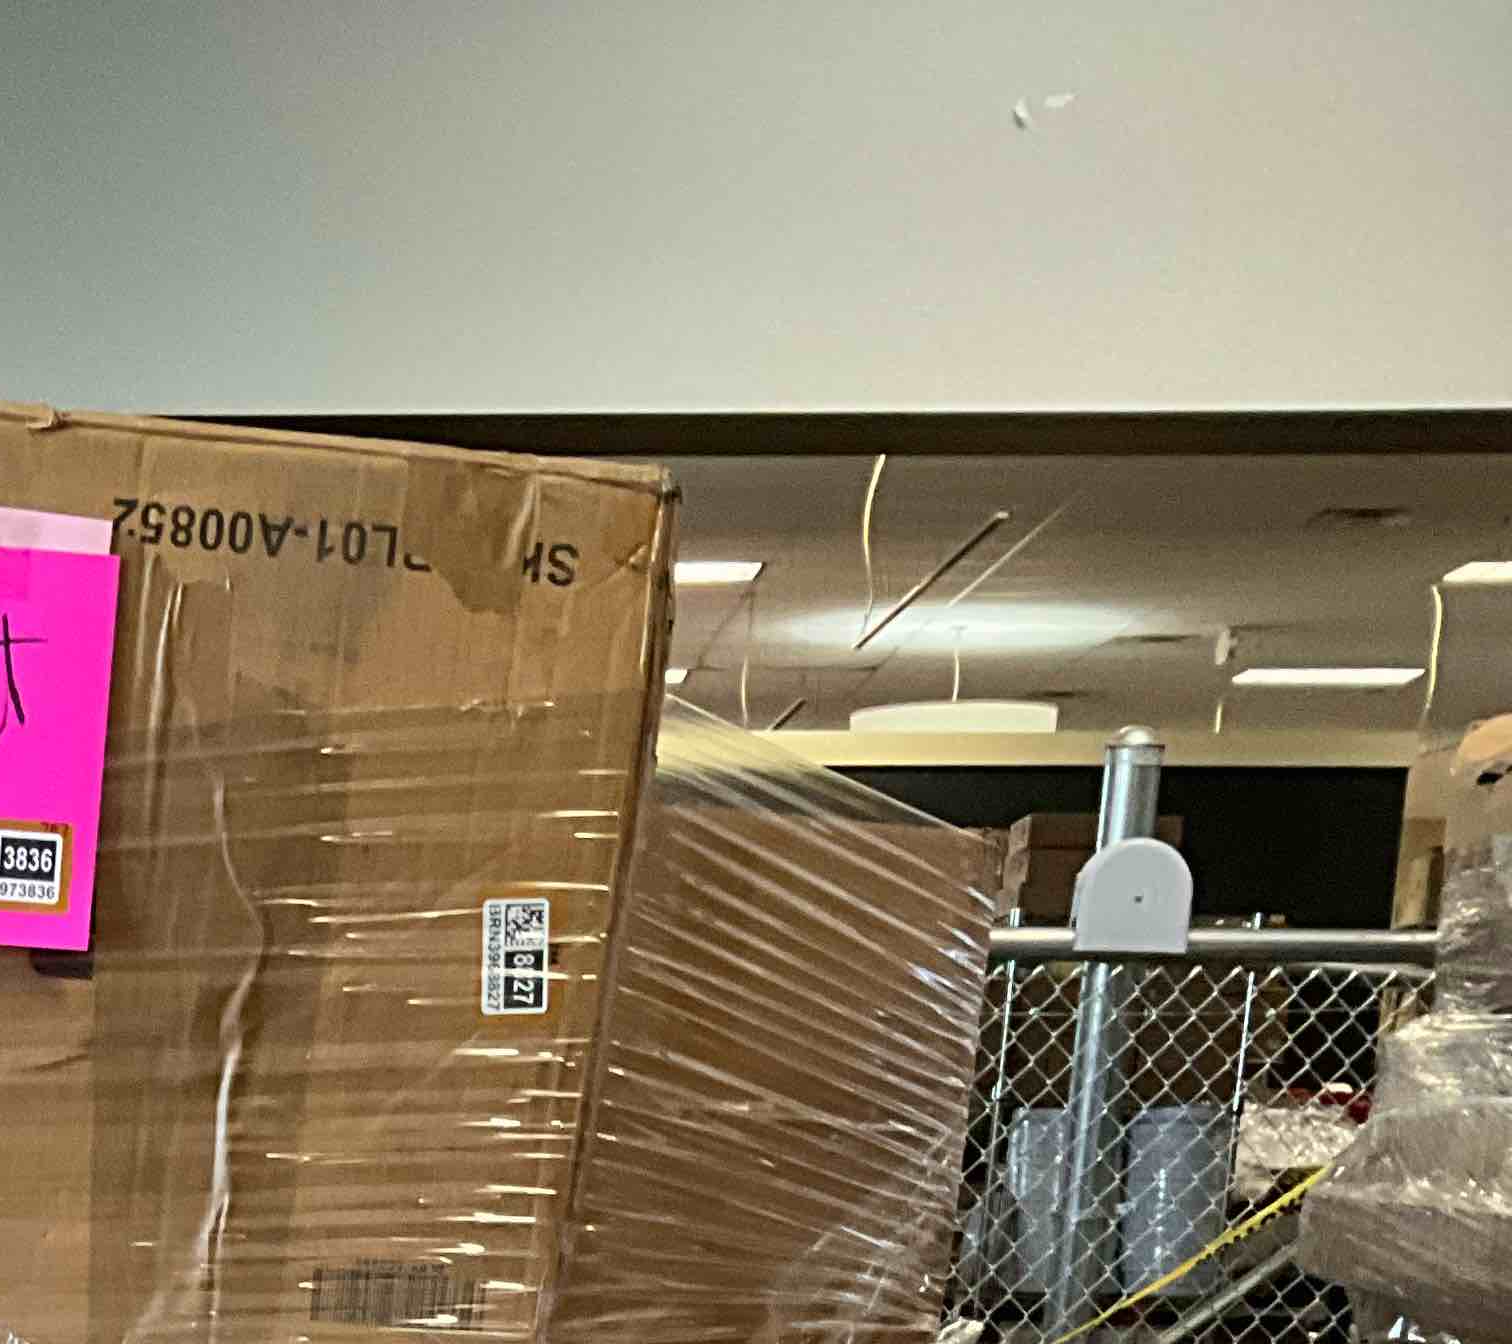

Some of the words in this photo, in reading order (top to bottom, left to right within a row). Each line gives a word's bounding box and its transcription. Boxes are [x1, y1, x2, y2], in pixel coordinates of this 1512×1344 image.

[112, 496, 433, 574] L01-A00852
[2, 845, 54, 873] 3836
[512, 952, 536, 1005] 827
